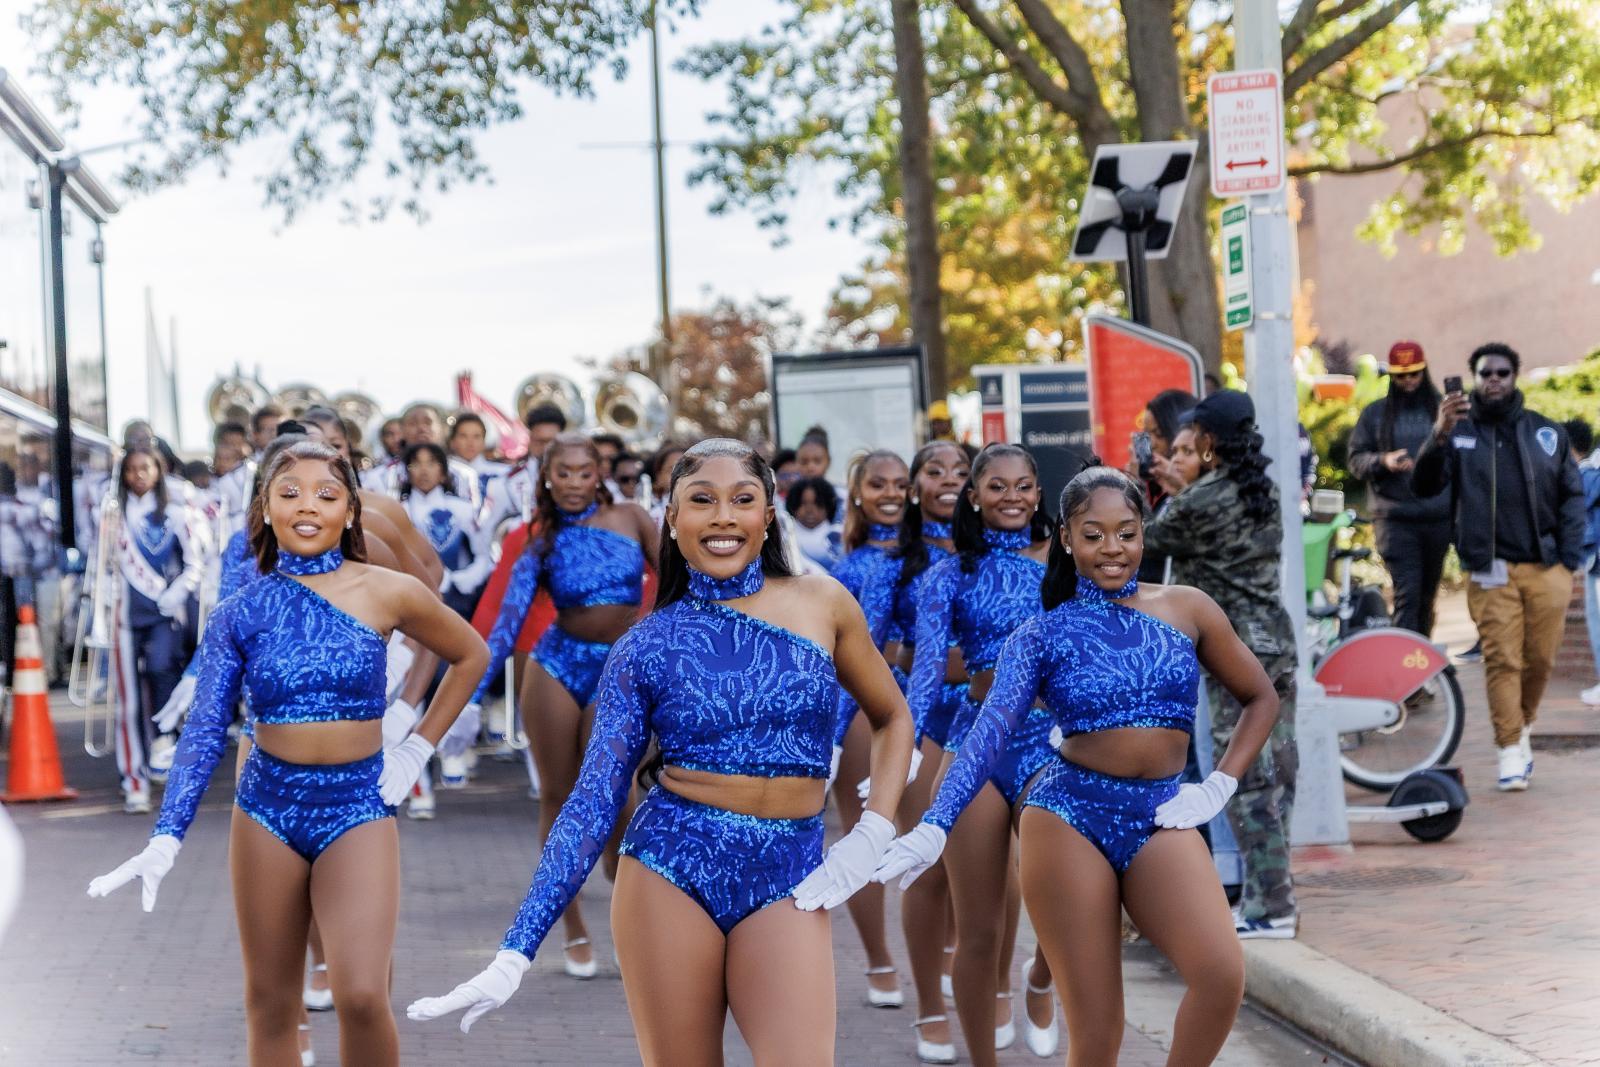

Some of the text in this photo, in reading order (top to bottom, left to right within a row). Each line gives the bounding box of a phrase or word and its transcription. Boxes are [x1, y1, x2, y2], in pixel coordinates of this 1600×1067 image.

[1237, 99, 1254, 109] NO
[1221, 113, 1271, 127] STANDING
[1227, 141, 1266, 153] ANYTIME
[1027, 430, 1066, 446] School
